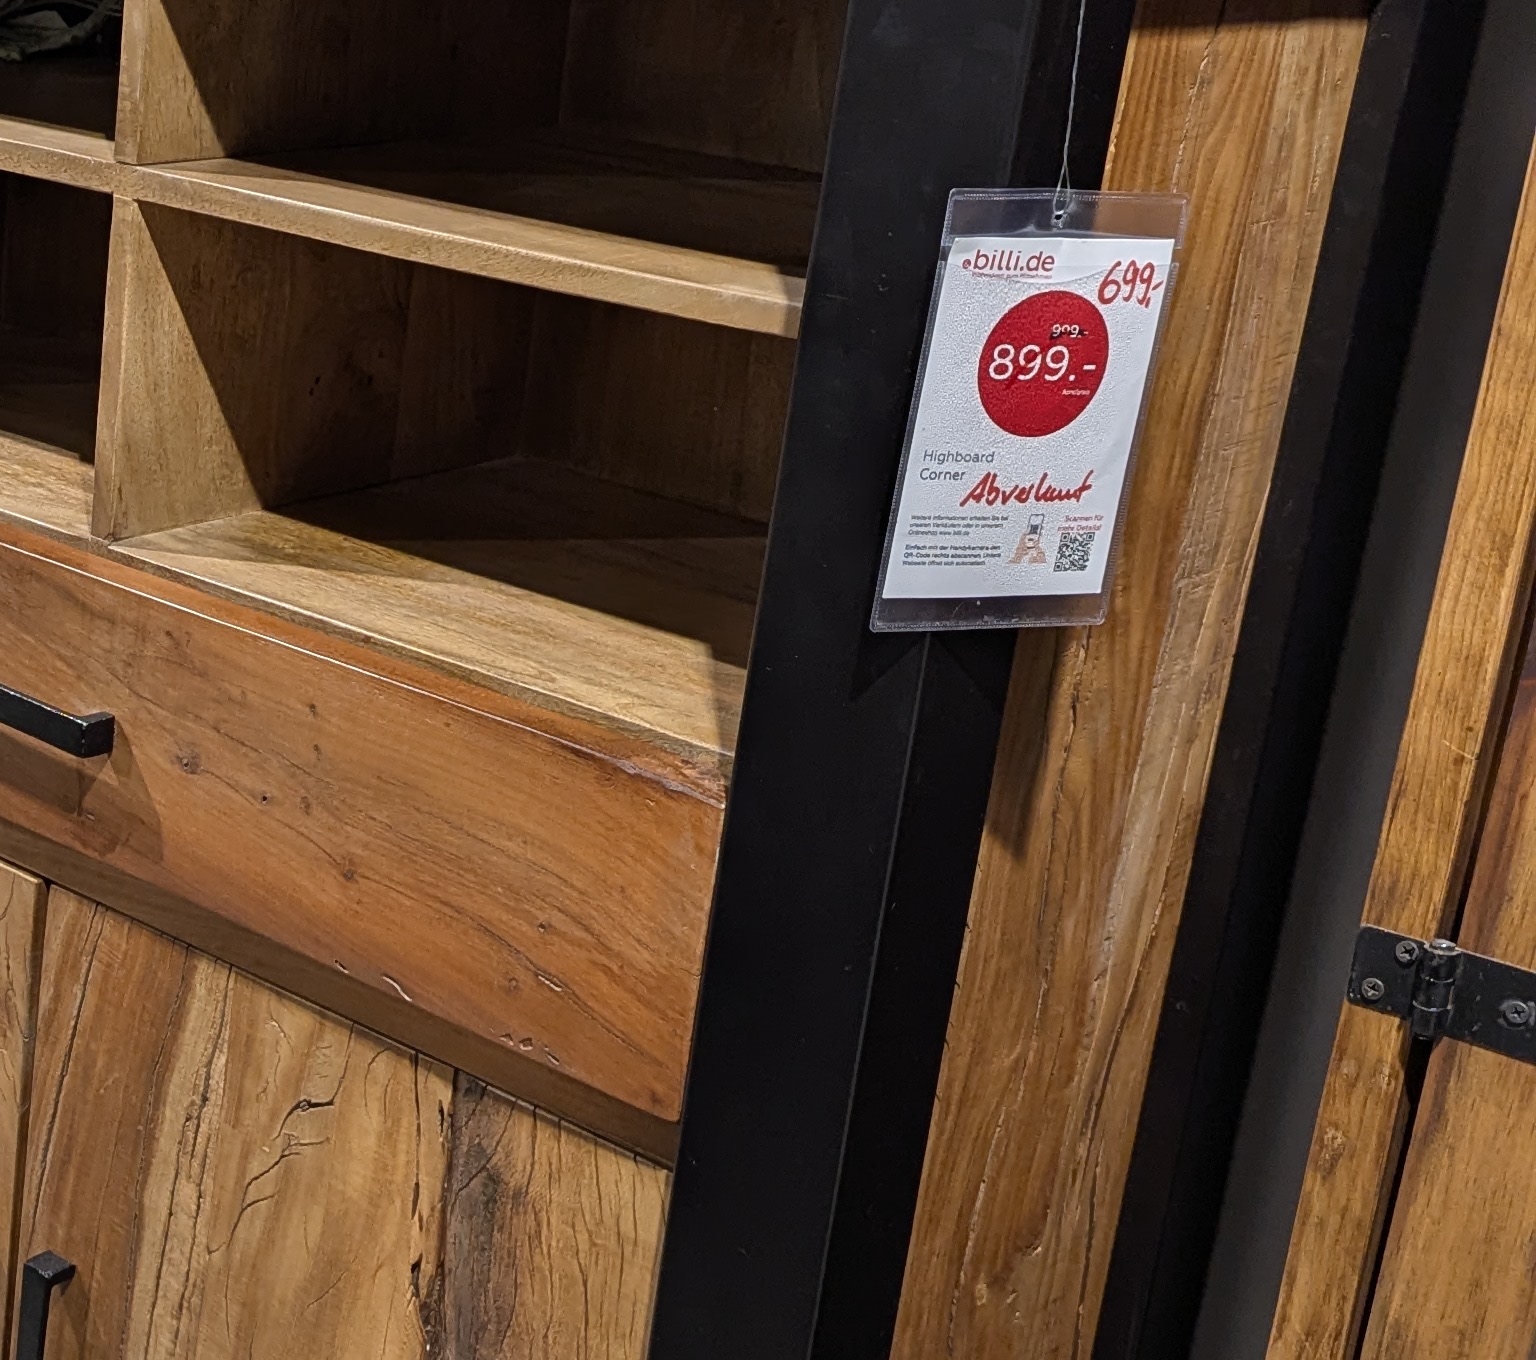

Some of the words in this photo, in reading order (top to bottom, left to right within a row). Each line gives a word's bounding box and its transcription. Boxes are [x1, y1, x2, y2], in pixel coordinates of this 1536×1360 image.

[988, 343, 1097, 382] 899.-
[923, 449, 995, 465] Highboard
[919, 467, 966, 481] Corner
